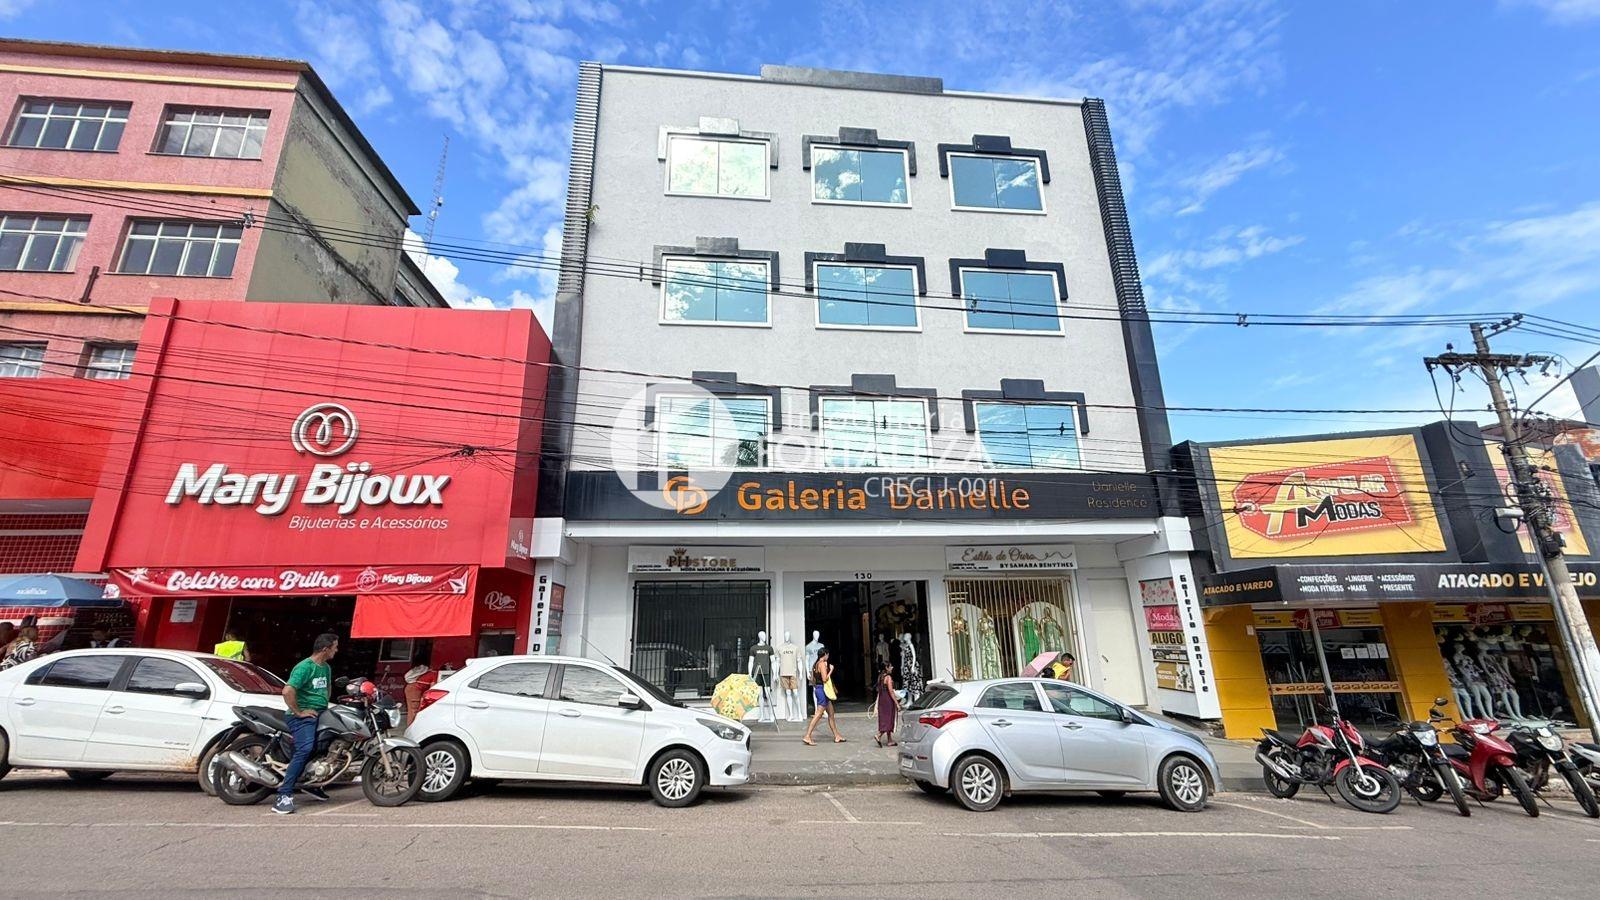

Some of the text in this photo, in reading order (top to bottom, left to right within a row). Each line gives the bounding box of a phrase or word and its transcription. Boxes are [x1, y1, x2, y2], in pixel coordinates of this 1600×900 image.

[165, 461, 452, 515] Mary Bijoux
[1092, 481, 1137, 492] Danielle
[737, 480, 1031, 511] Galeria Danielle
[1296, 495, 1382, 529] MODAS
[288, 515, 449, 532] Bijuterias e Acessórios
[961, 547, 993, 562] Estilo
[995, 548, 1007, 561] de
[692, 558, 737, 568] STORE
[166, 570, 340, 591] Celebre com Brilho
[382, 573, 435, 585] Mary Bijoux
[854, 572, 873, 580] 130
[1300, 572, 1416, 584] CONFECÇÕES LINGERIE ACESSÓRIOS
[1437, 572, 1597, 588] ATACADO E VEJO
[1203, 580, 1274, 595] ATACADO E VAREJO
[1302, 583, 1413, 593] MODA FITNESS MAKE PRESENTE
[534, 575, 547, 635] Galeria
[1180, 574, 1209, 693] Galeria Daniele
